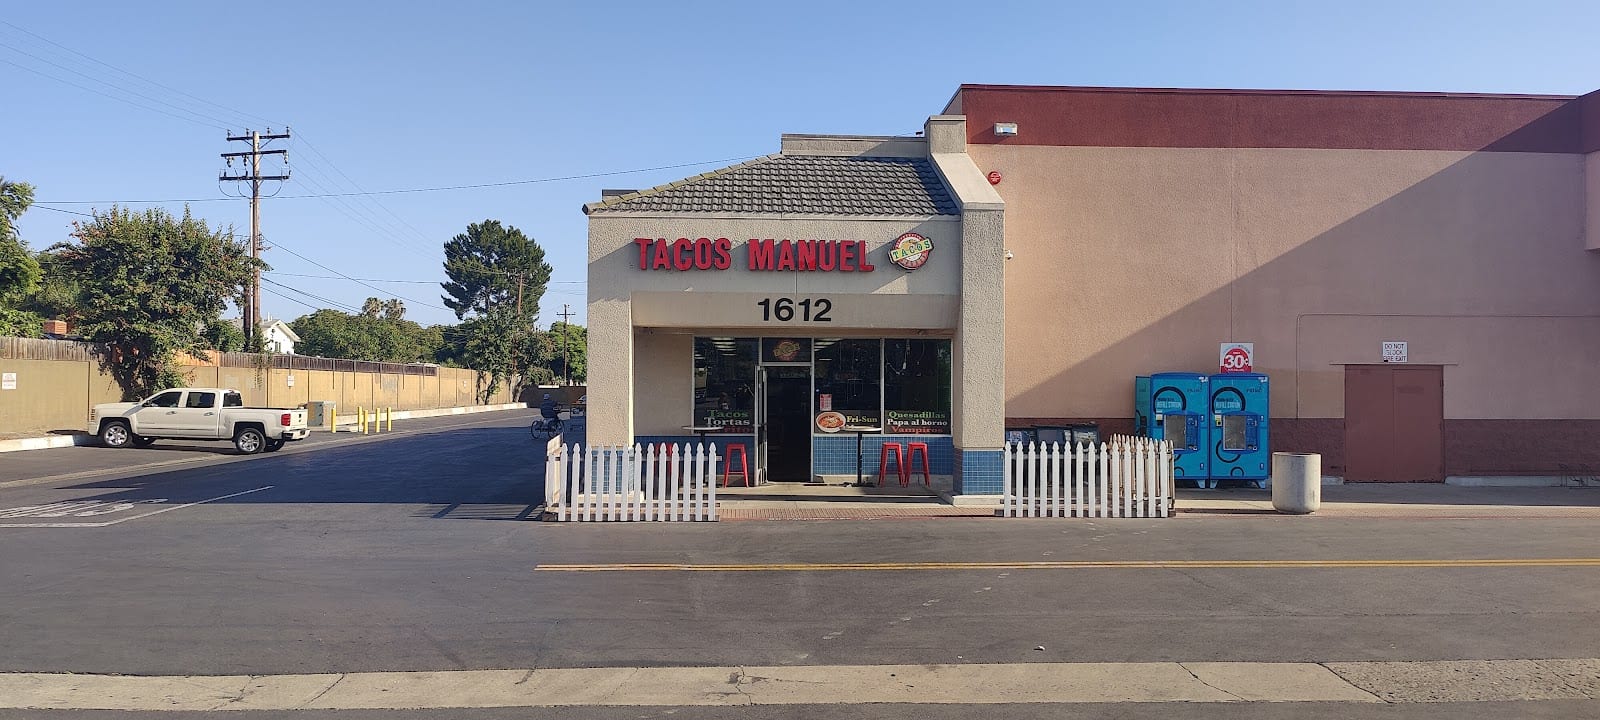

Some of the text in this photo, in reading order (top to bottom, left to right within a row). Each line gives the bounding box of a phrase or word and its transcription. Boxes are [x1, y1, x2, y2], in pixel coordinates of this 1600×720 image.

[634, 237, 732, 271] TACOS
[748, 238, 875, 272] MANUEL
[892, 240, 931, 259] TACOS
[757, 298, 832, 322] 1612
[707, 410, 749, 418] Tacos
[846, 415, 878, 423] Fri-Sun
[888, 411, 946, 420] Quesadillas
[703, 416, 750, 426] Tortas
[887, 418, 948, 427] Papa al horno
[891, 425, 943, 435] Vampiros
